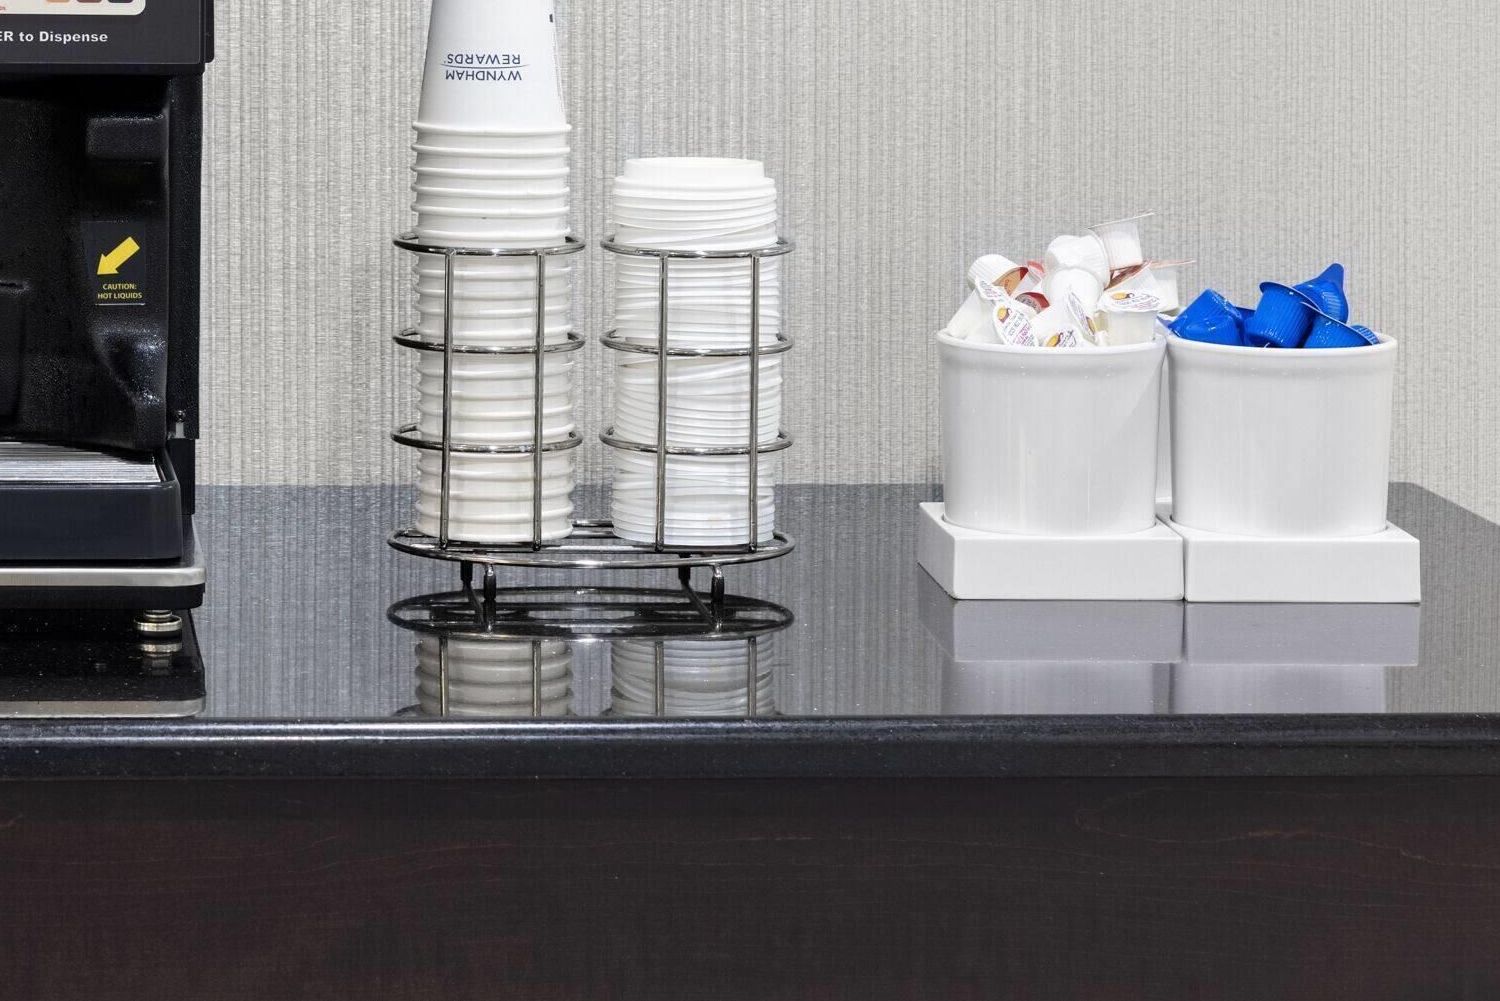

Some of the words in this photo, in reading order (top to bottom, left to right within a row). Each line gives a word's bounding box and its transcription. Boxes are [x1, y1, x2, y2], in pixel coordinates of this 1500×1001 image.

[19, 32, 33, 42] to
[38, 31, 108, 44] Dispense
[447, 54, 521, 65] REWARDS
[445, 70, 522, 81] WYNDHAM
